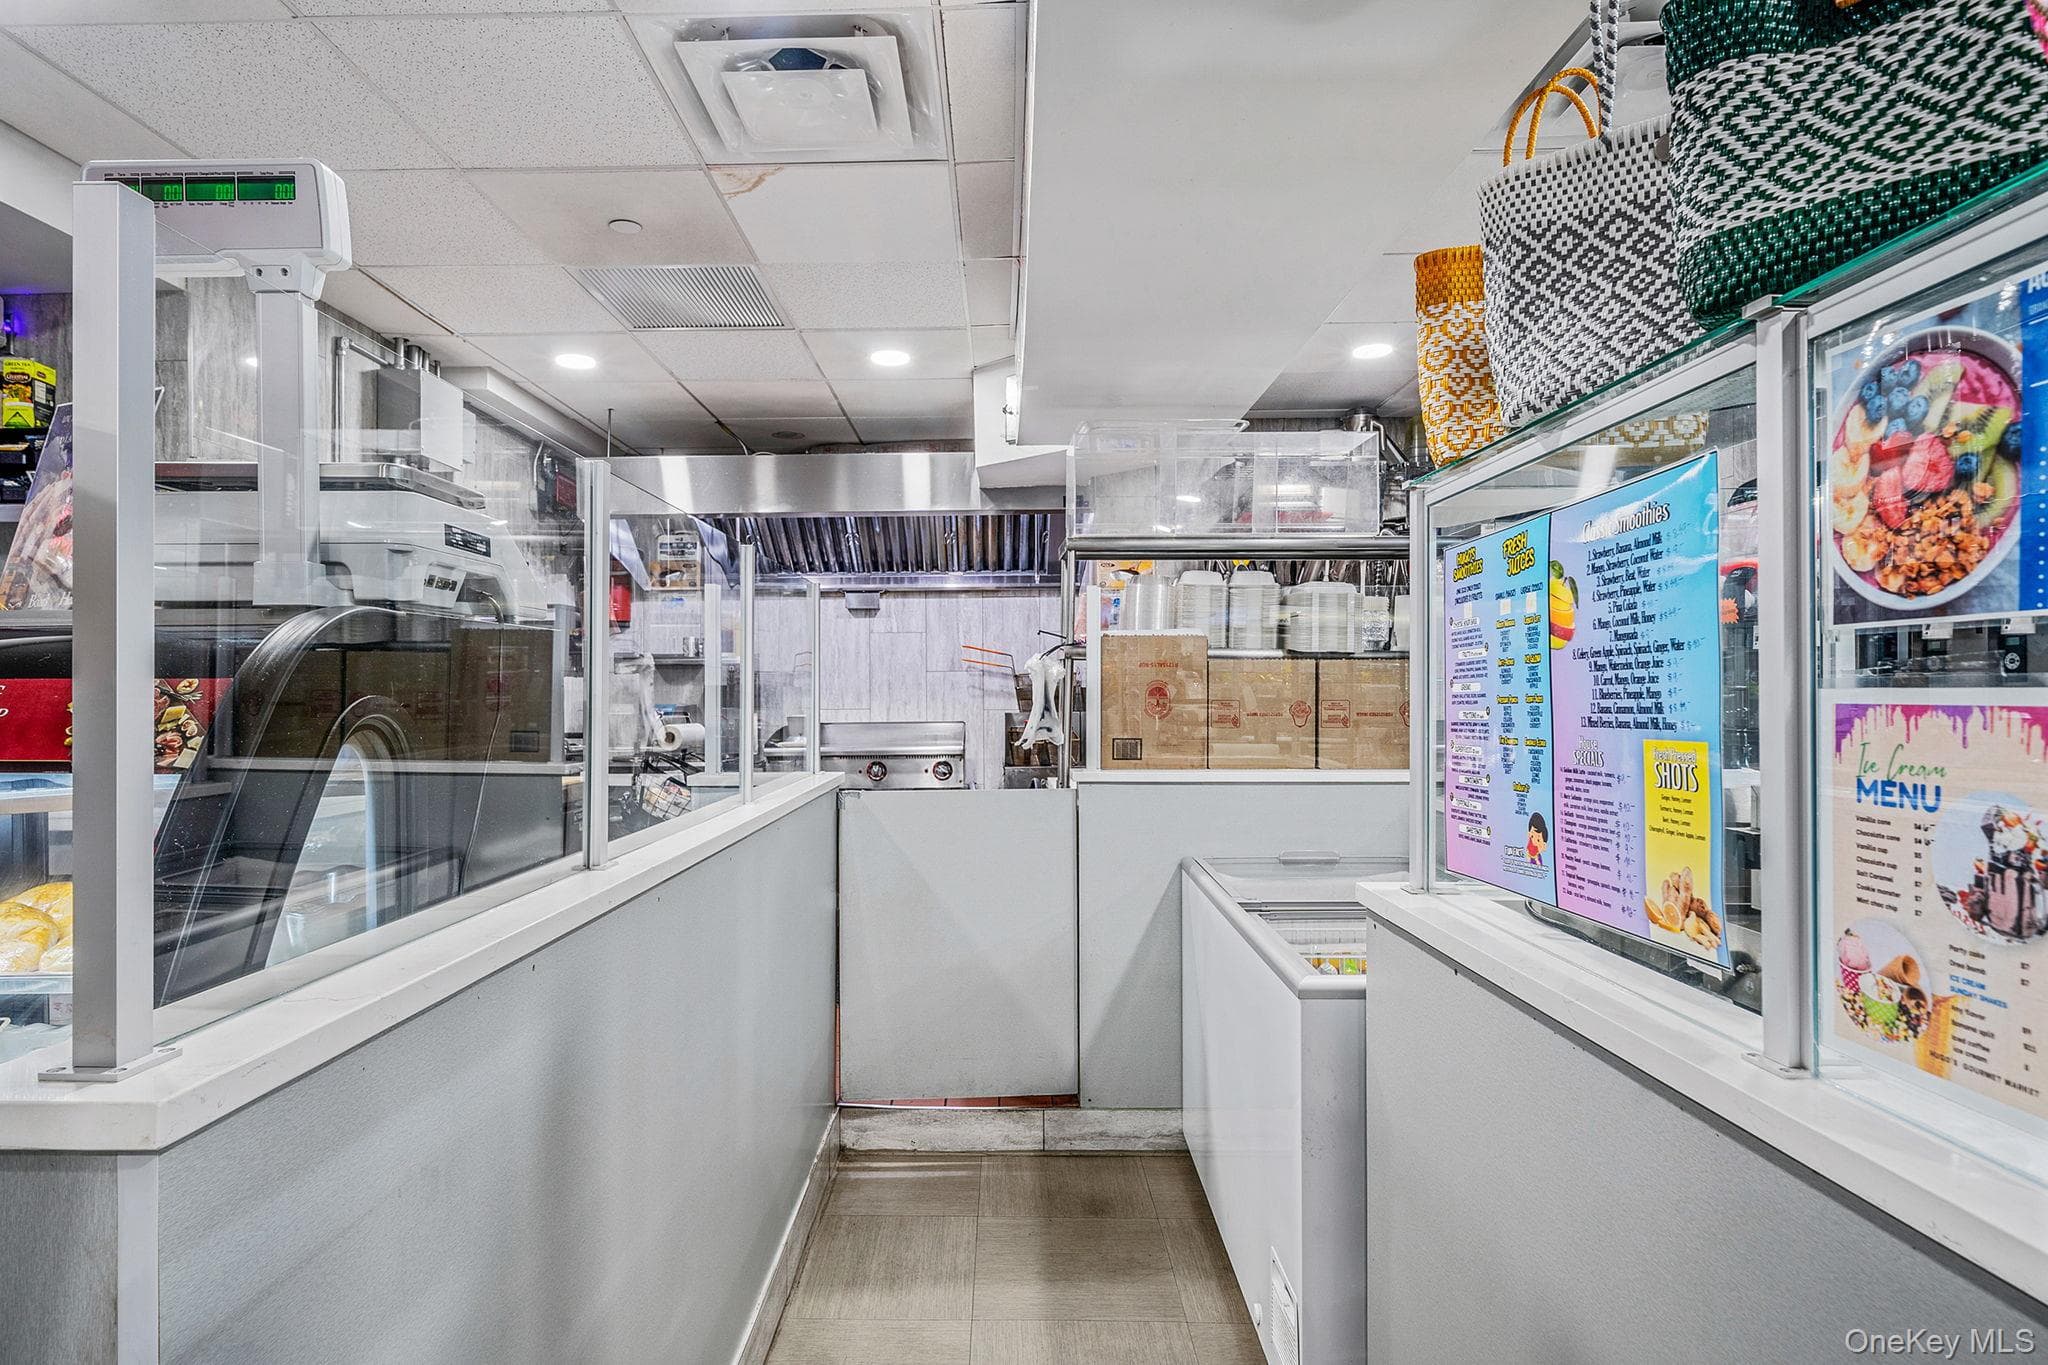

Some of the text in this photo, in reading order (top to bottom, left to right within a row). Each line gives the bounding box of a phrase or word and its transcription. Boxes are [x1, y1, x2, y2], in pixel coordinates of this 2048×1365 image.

[1615, 501, 1670, 535] Smoothies
[1503, 530, 1529, 559] FRESH
[1592, 546, 1615, 561] Strawberry,
[1615, 543, 1632, 555] Banana,
[1634, 534, 1651, 550] Almond
[1652, 531, 1663, 545] Milk
[1456, 547, 1477, 566] HUGO'S
[1506, 547, 1535, 578] JUICES
[1606, 557, 1629, 572] Strawberry,
[1630, 553, 1649, 566] Coconut
[1649, 549, 1664, 562] Water
[1453, 558, 1484, 582] SMOOTHIES
[1601, 573, 1625, 587] Strawberry,
[1637, 566, 1651, 579] Water
[1596, 588, 1620, 602] Strawberry,
[1642, 581, 1657, 593] Water
[1623, 598, 1638, 610] Colada
[1612, 616, 1630, 627] Coconut
[1642, 611, 1656, 625] Honey
[1589, 646, 1602, 659] Green
[1670, 638, 1686, 651] Water
[1634, 657, 1650, 671] Orange
[1652, 656, 1664, 668] Juice
[1630, 672, 1646, 685] Orange
[1647, 671, 1659, 684] Juice
[1646, 687, 1662, 701] Mango
[1636, 702, 1653, 714] Almond
[1653, 701, 1665, 714] Milk
[1633, 717, 1649, 730] Almond
[1662, 717, 1677, 733] Honey
[1577, 736, 1598, 750] House
[1573, 750, 1605, 768] SPECIALS
[1654, 746, 1697, 763] Fresh Pressed
[1855, 742, 1948, 782] Ice Cream
[1654, 761, 1700, 793] SHOTS
[1856, 778, 1942, 814] MENU
[1856, 816, 1876, 824] Vanilla
[1856, 829, 1885, 839] Chocolate
[1856, 843, 1877, 852] Vanilla
[1856, 856, 1886, 867] Chocolate
[1869, 872, 1894, 883] Caramel
[1856, 883, 1876, 893] Cookie
[1877, 889, 1902, 898] monster
[1856, 897, 1870, 905] Mint
[1870, 900, 1884, 909] choc
[1885, 904, 1898, 912] chip
[1949, 944, 1968, 956] Party
[1968, 951, 1986, 960] cake
[1949, 960, 1965, 969] Oreo
[1966, 964, 1986, 975] bomb
[1950, 975, 1986, 990] ICE CREAM
[1979, 994, 2008, 1009] SHAKES
[1951, 1019, 1978, 1034] Banana
[1967, 1040, 1991, 1053] coffee
[1965, 1051, 1988, 1063] cream
[1963, 1063, 2002, 1081] GOURMET
[2005, 1079, 2040, 1098] MARKET
